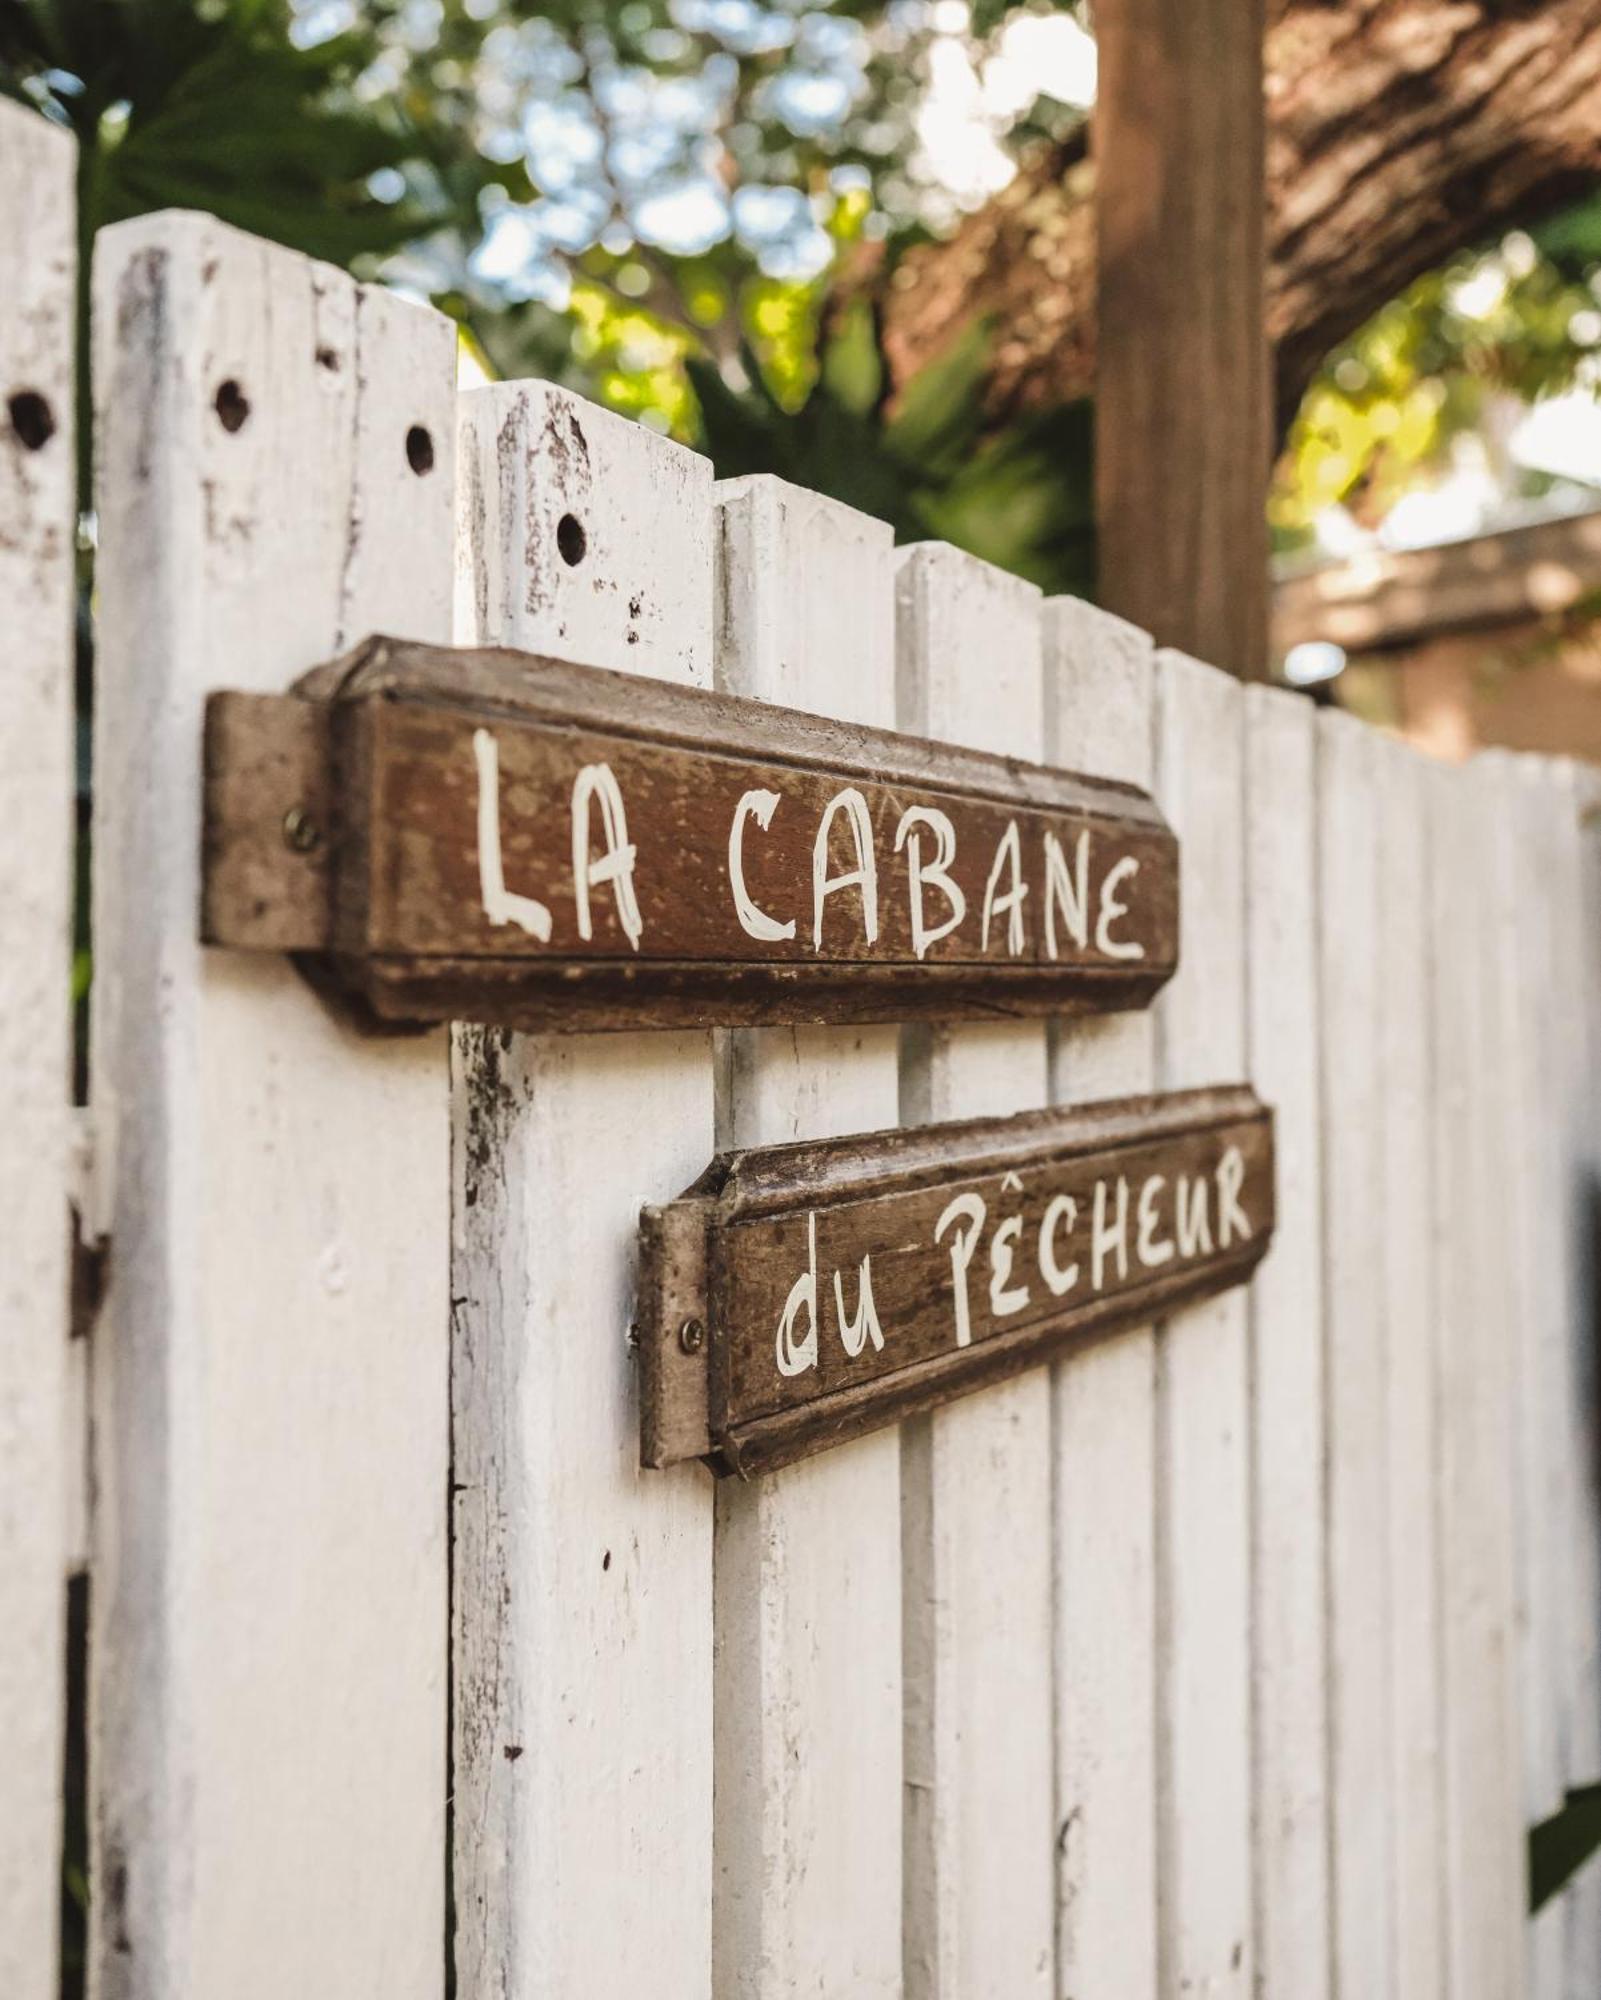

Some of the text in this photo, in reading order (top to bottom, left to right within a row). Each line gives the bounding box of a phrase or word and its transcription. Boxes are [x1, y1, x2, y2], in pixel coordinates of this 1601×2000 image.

[473, 728, 1146, 961] LA CABANE
[775, 1210, 886, 1377] du
